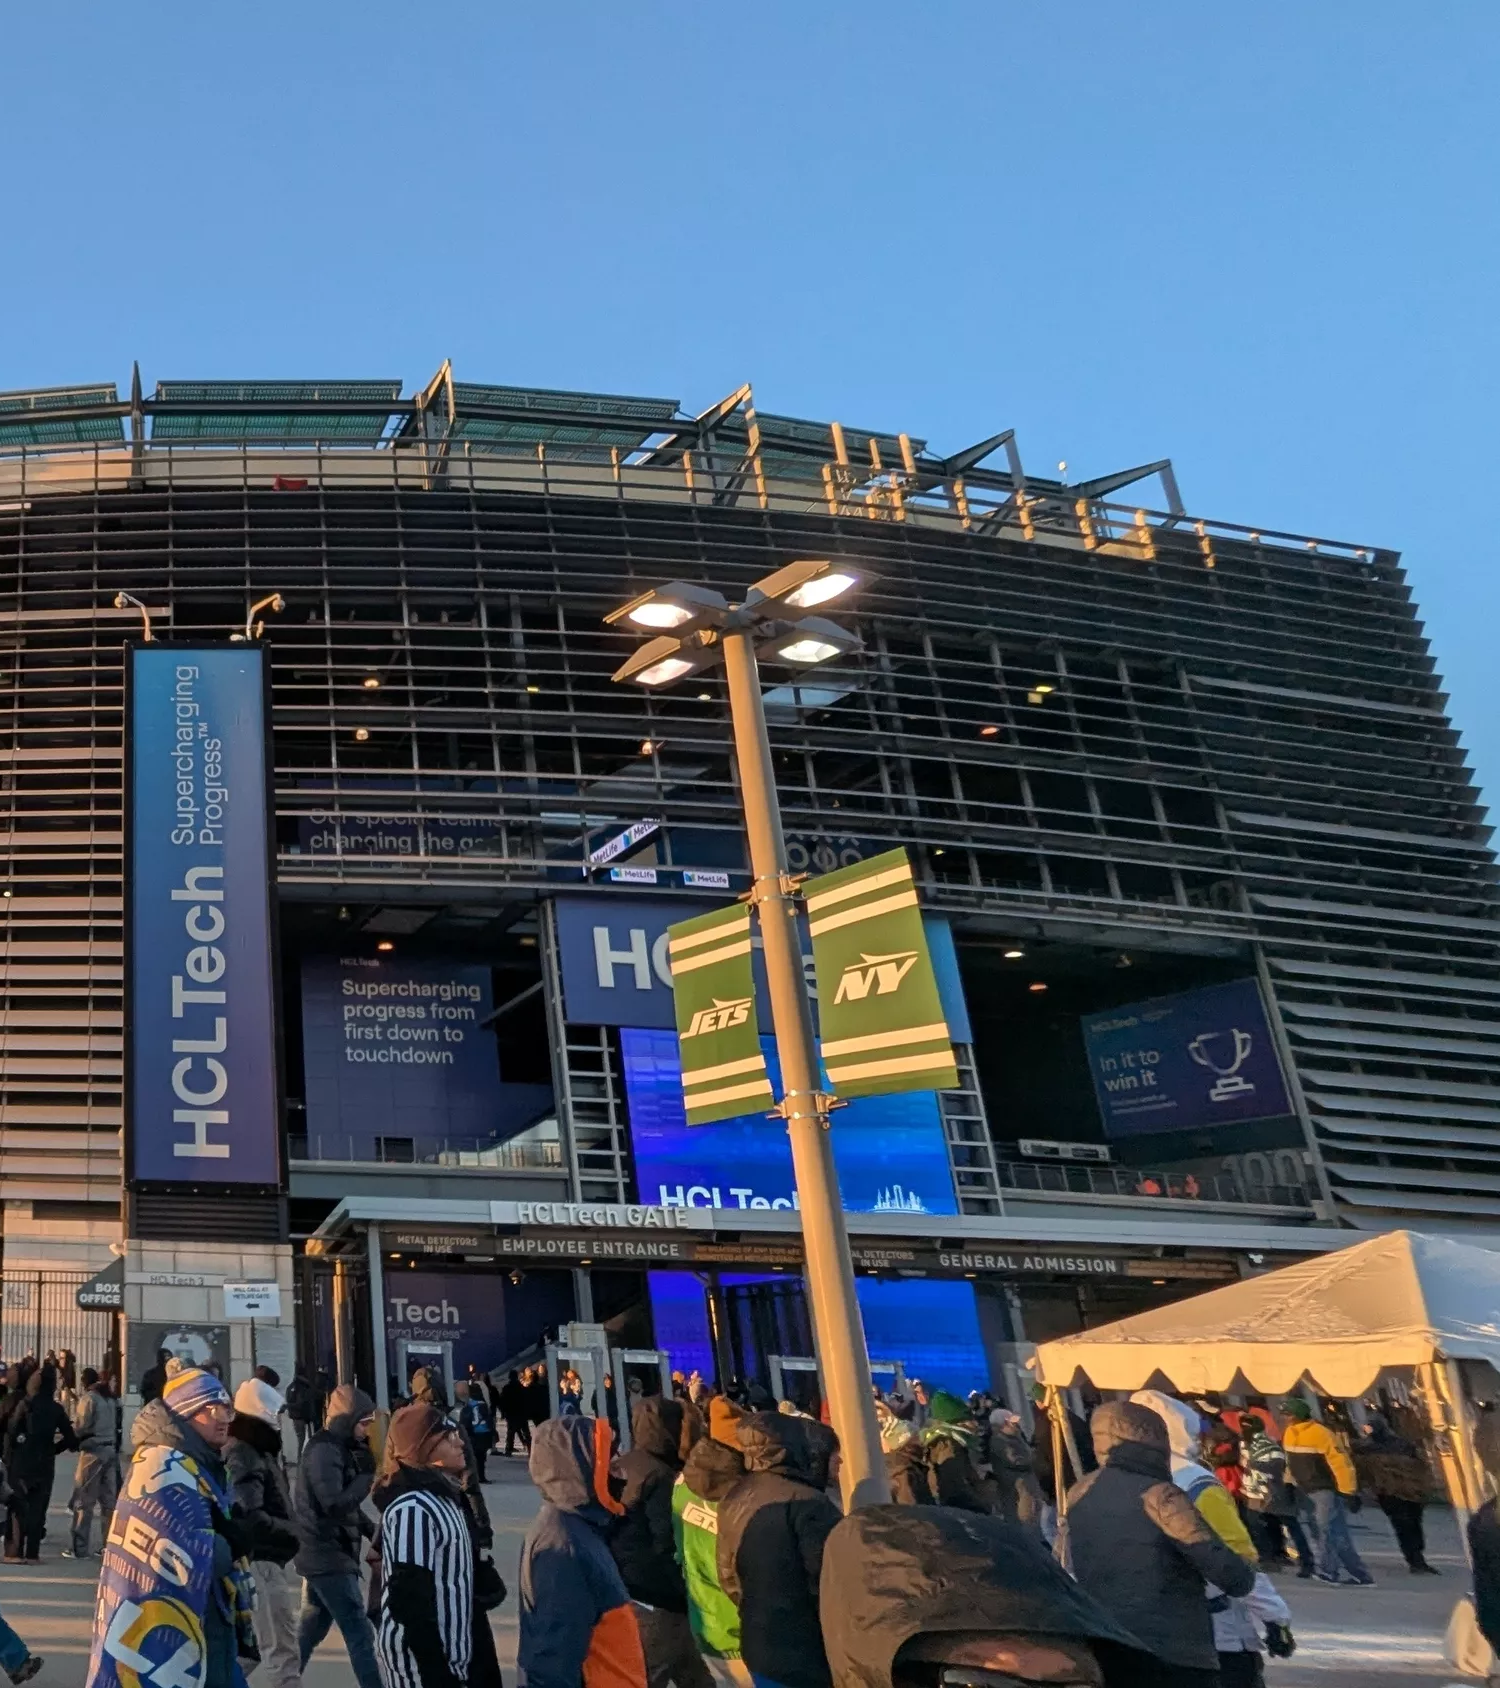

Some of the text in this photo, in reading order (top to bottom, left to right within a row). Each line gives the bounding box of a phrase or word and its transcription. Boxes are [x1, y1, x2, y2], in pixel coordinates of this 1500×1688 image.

[171, 665, 200, 845] Supercharging
[310, 830, 412, 853] changing
[593, 843, 619, 864] MetLife
[624, 870, 655, 879] MetLife
[697, 875, 727, 884] MetLife
[833, 952, 919, 1005] NY
[342, 980, 481, 1002] Supercharging
[171, 866, 230, 1158] HCLTech
[344, 1003, 475, 1022] progress from
[680, 997, 752, 1040] JETS
[344, 1023, 464, 1042] first down to
[345, 1046, 453, 1064] touchdown
[1100, 1050, 1160, 1072] In it to
[1104, 1069, 1157, 1091] win it
[659, 1185, 800, 1210] HCLTec
[517, 1203, 689, 1227] HCLTech GATE
[397, 1235, 477, 1246] METAL DETECTORS
[435, 1245, 452, 1253] USE
[502, 1239, 587, 1253] EMPLOYEE
[593, 1241, 679, 1256] ENTRANCE
[861, 1259, 890, 1267] IN USE
[864, 1251, 914, 1260] DETECTORS
[939, 1253, 1018, 1270] GENERAL
[1023, 1255, 1117, 1273] ADMISSION
[95, 1283, 120, 1293] BOX
[79, 1294, 120, 1305] OFFICE
[387, 1299, 459, 1324] Tech
